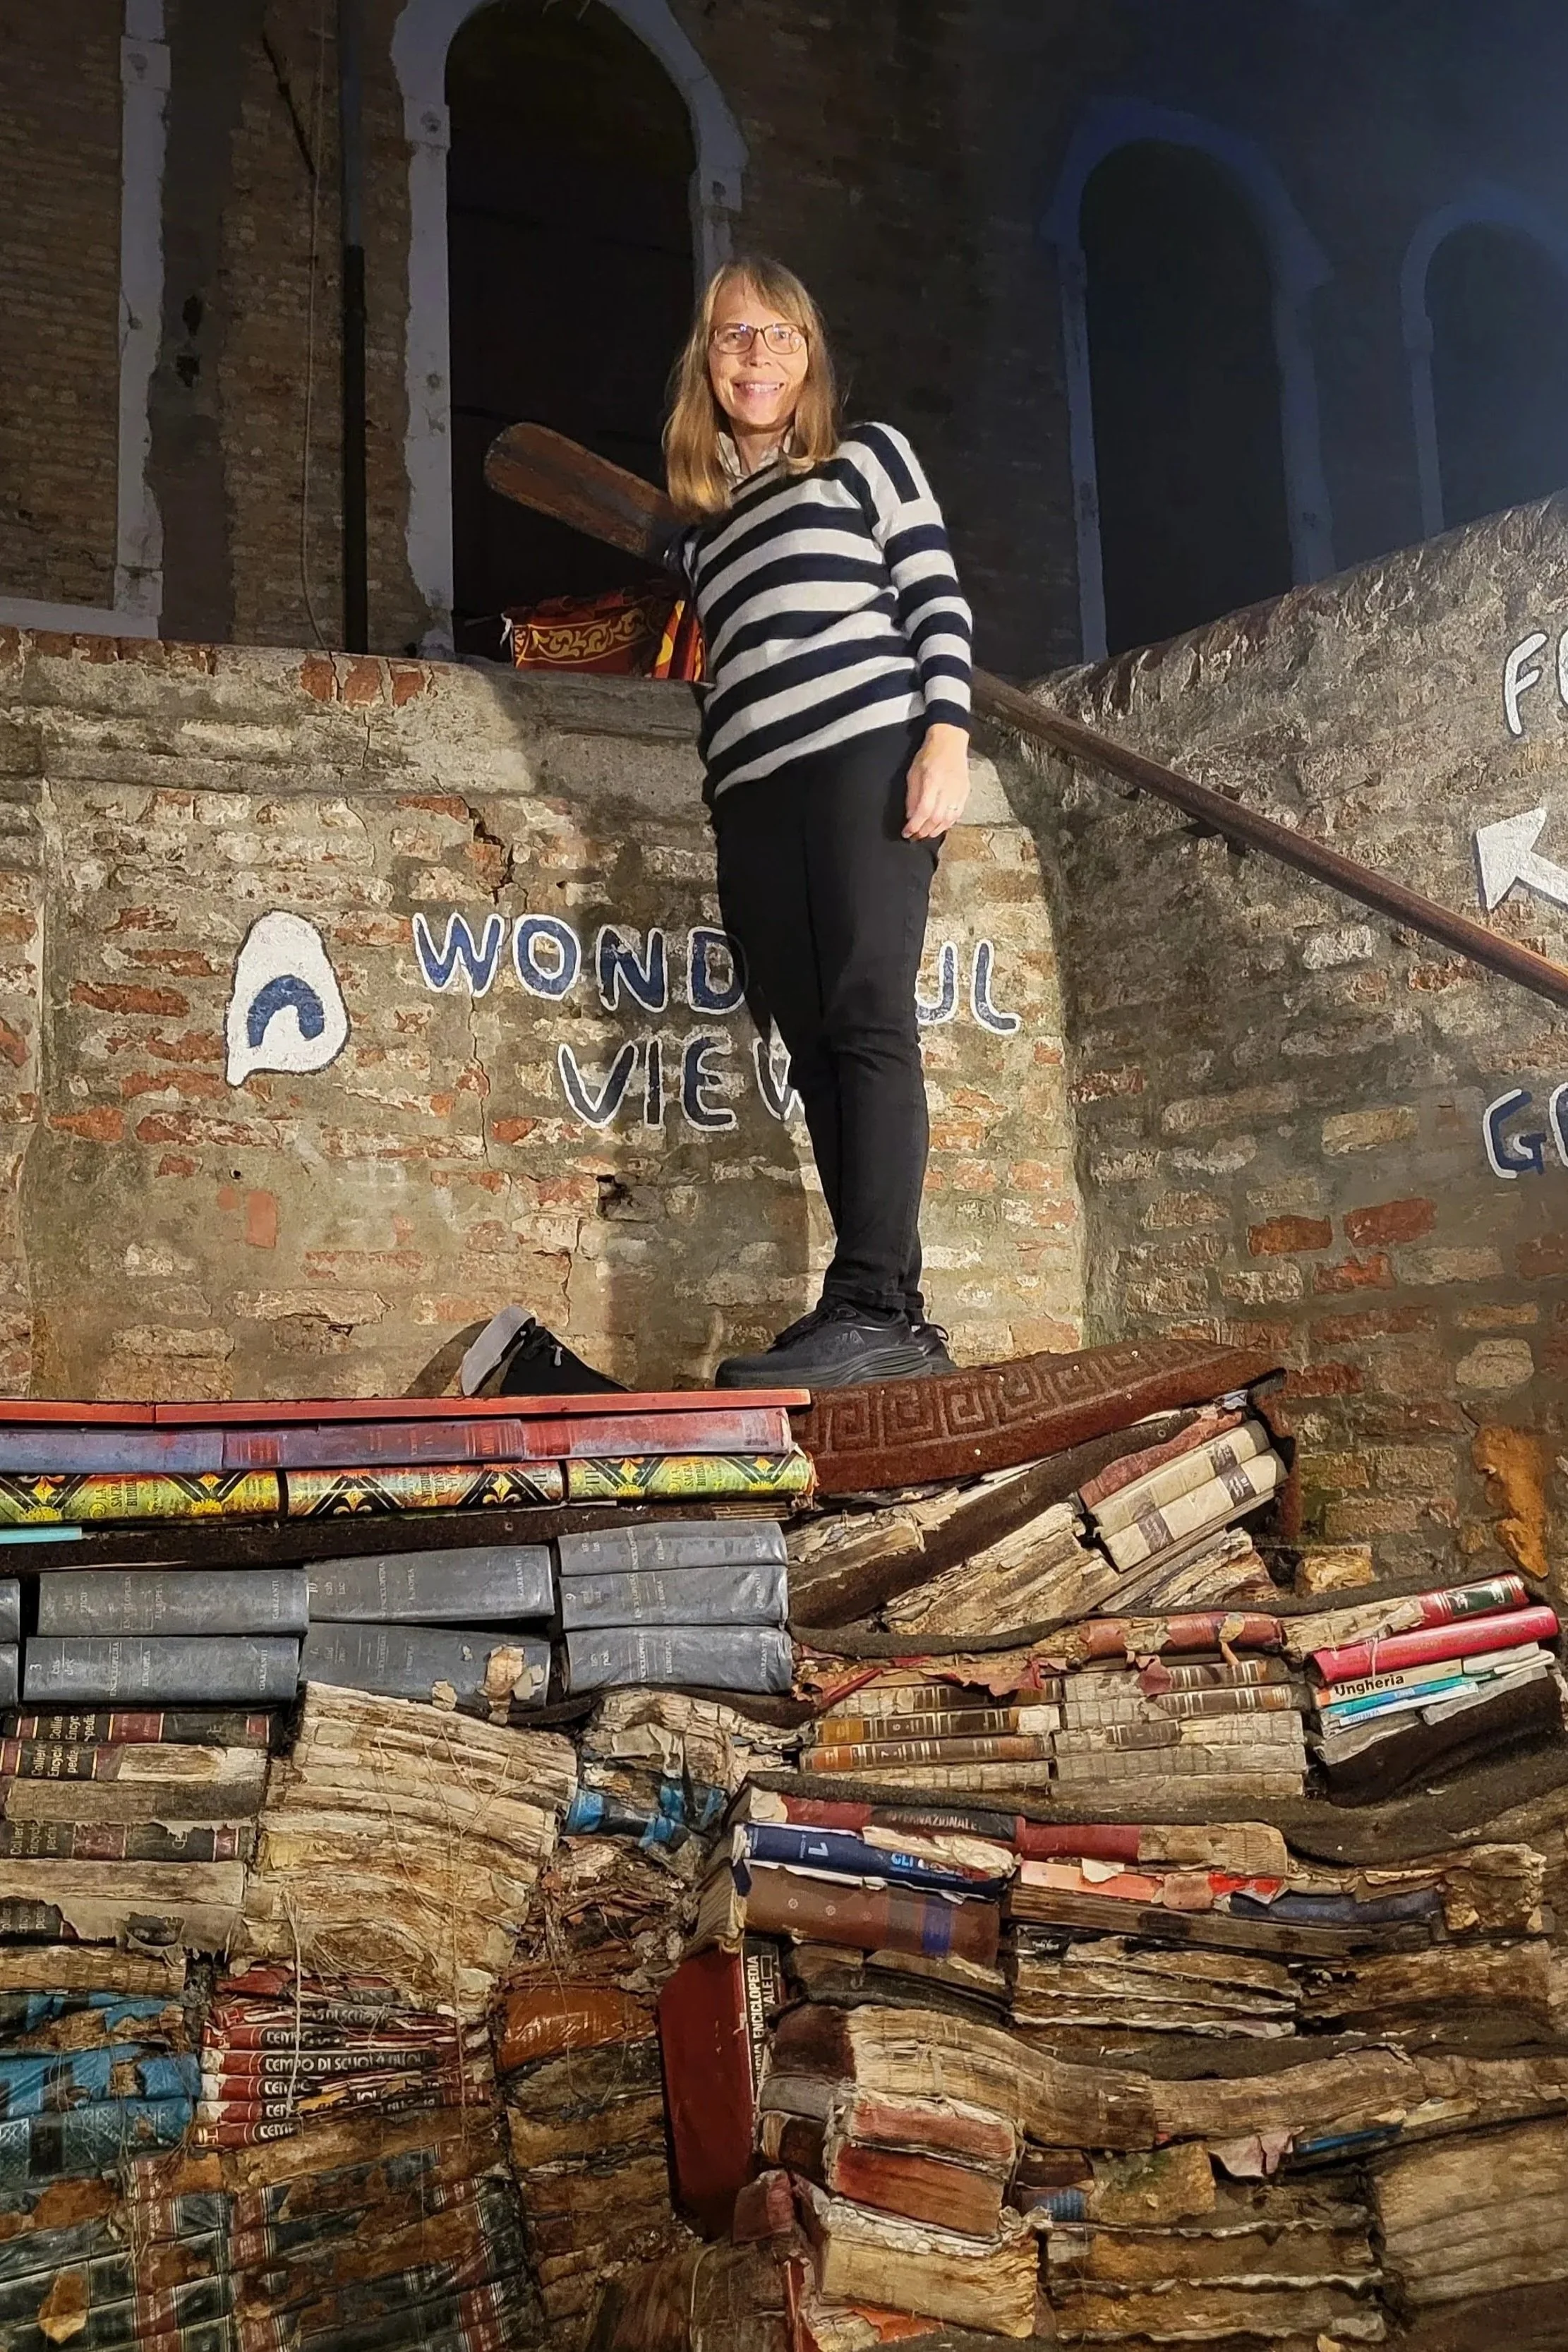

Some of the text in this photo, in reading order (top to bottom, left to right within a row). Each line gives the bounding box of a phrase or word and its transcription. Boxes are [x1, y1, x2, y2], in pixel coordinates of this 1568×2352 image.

[1503, 628, 1568, 736] F
[413, 912, 1021, 1035] WONDUL
[1483, 1081, 1568, 1179] G
[271, 1579, 280, 1620] GARZANTI
[565, 1593, 577, 1601] 9
[30, 1663, 42, 1671] 3
[1334, 1674, 1404, 1696] Ungheria
[66, 1715, 80, 1742] Encyc
[67, 1746, 79, 1774] pedia
[807, 1842, 829, 1857] 1
[891, 1852, 914, 1868] GLI
[747, 1955, 765, 2039] ENCICLOPEDIA
[318, 2057, 332, 2071] DI
